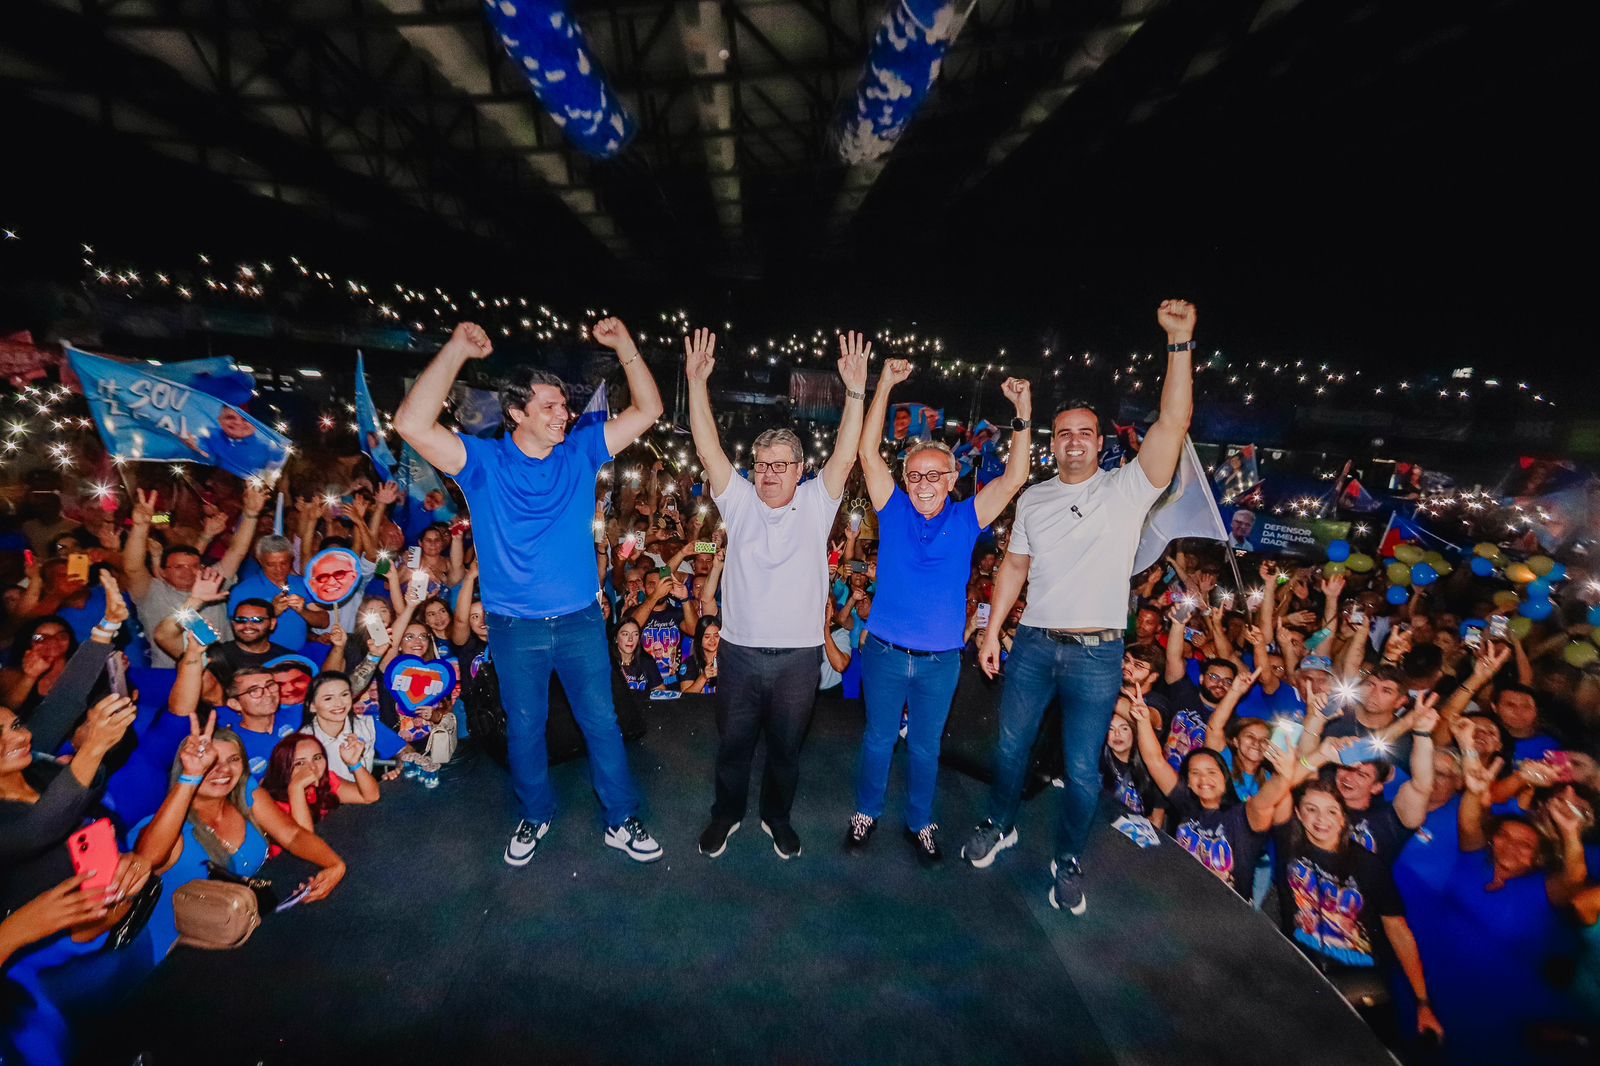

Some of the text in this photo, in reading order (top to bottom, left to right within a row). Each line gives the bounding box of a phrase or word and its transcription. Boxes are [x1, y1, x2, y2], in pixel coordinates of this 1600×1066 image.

[1264, 523, 1312, 536] DEFENSOR
[1260, 537, 1288, 548] IDADE
[1262, 530, 1316, 545] DA MELHOR
